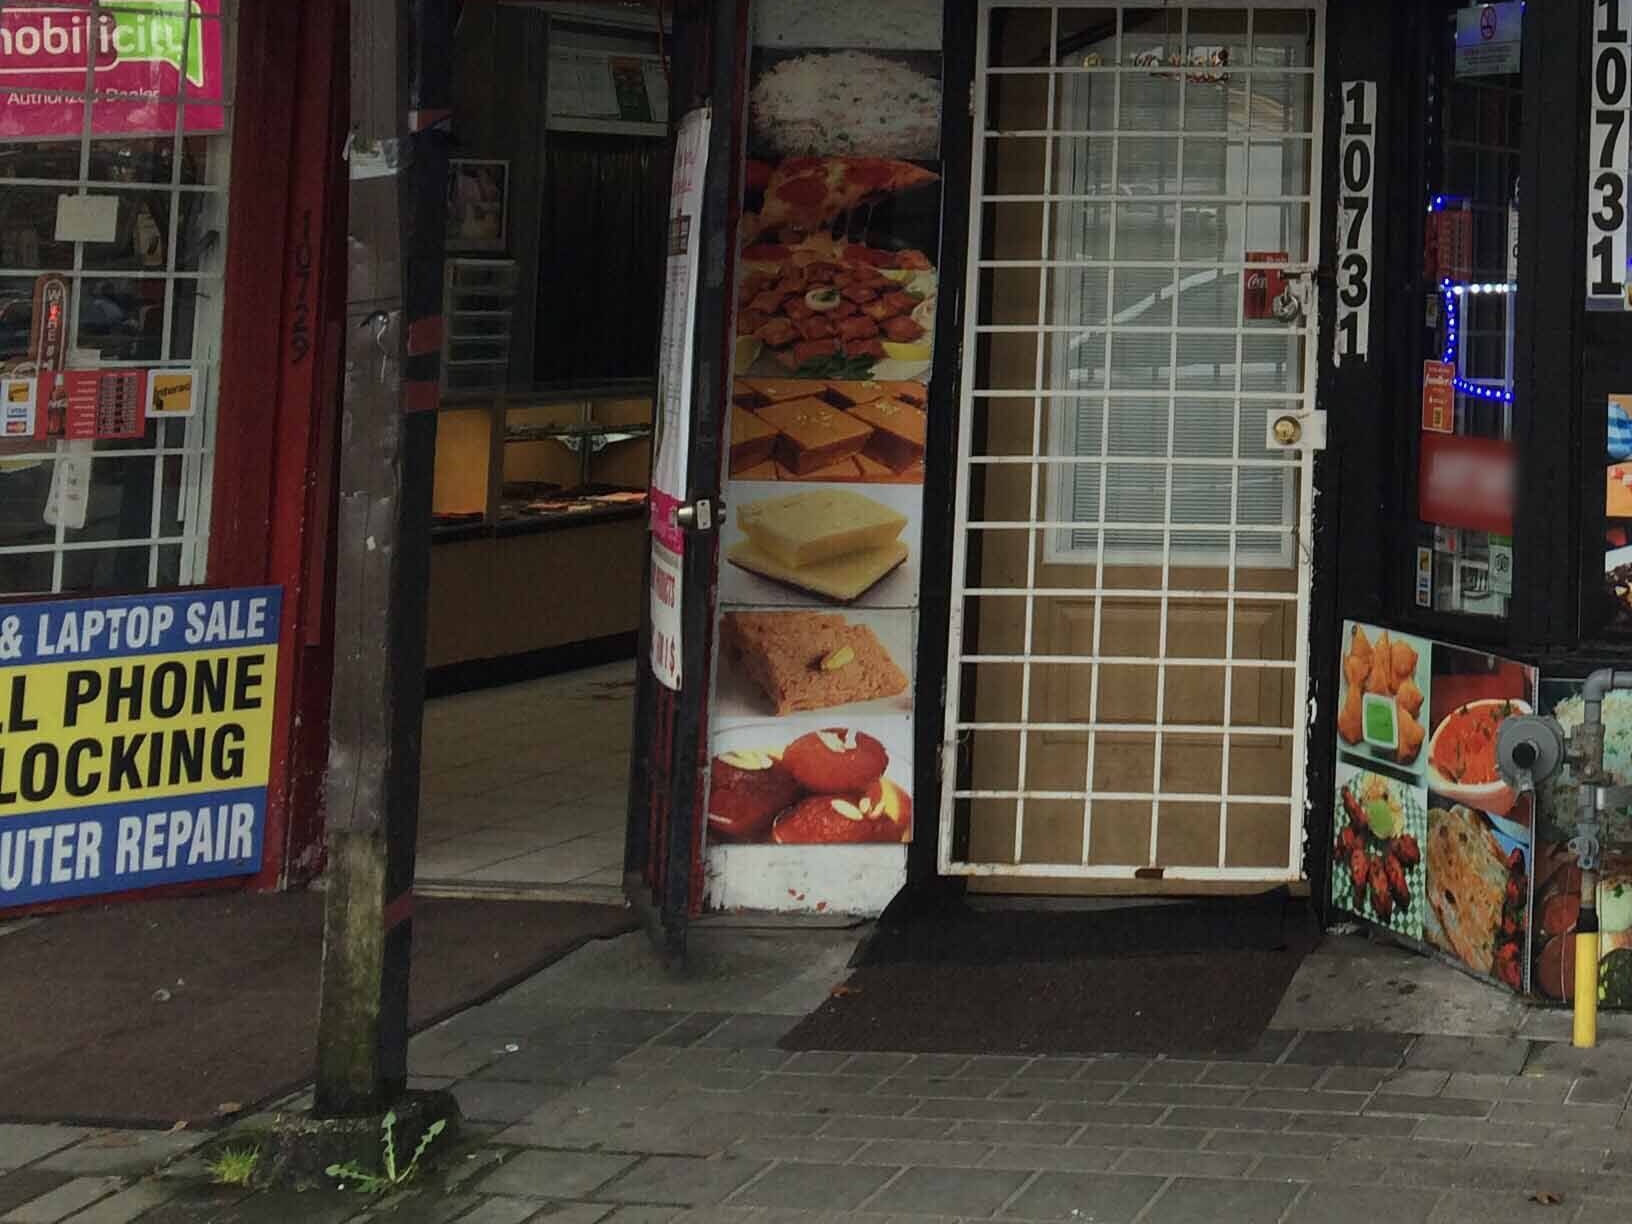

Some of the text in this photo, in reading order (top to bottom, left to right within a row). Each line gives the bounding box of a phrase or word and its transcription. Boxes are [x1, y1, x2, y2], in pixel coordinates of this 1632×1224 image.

[1339, 81, 1372, 361] 10731
[0, 597, 268, 660] & LAPTOP SALE
[0, 654, 265, 733] L PHONE
[116, 802, 256, 875] REPAIR
